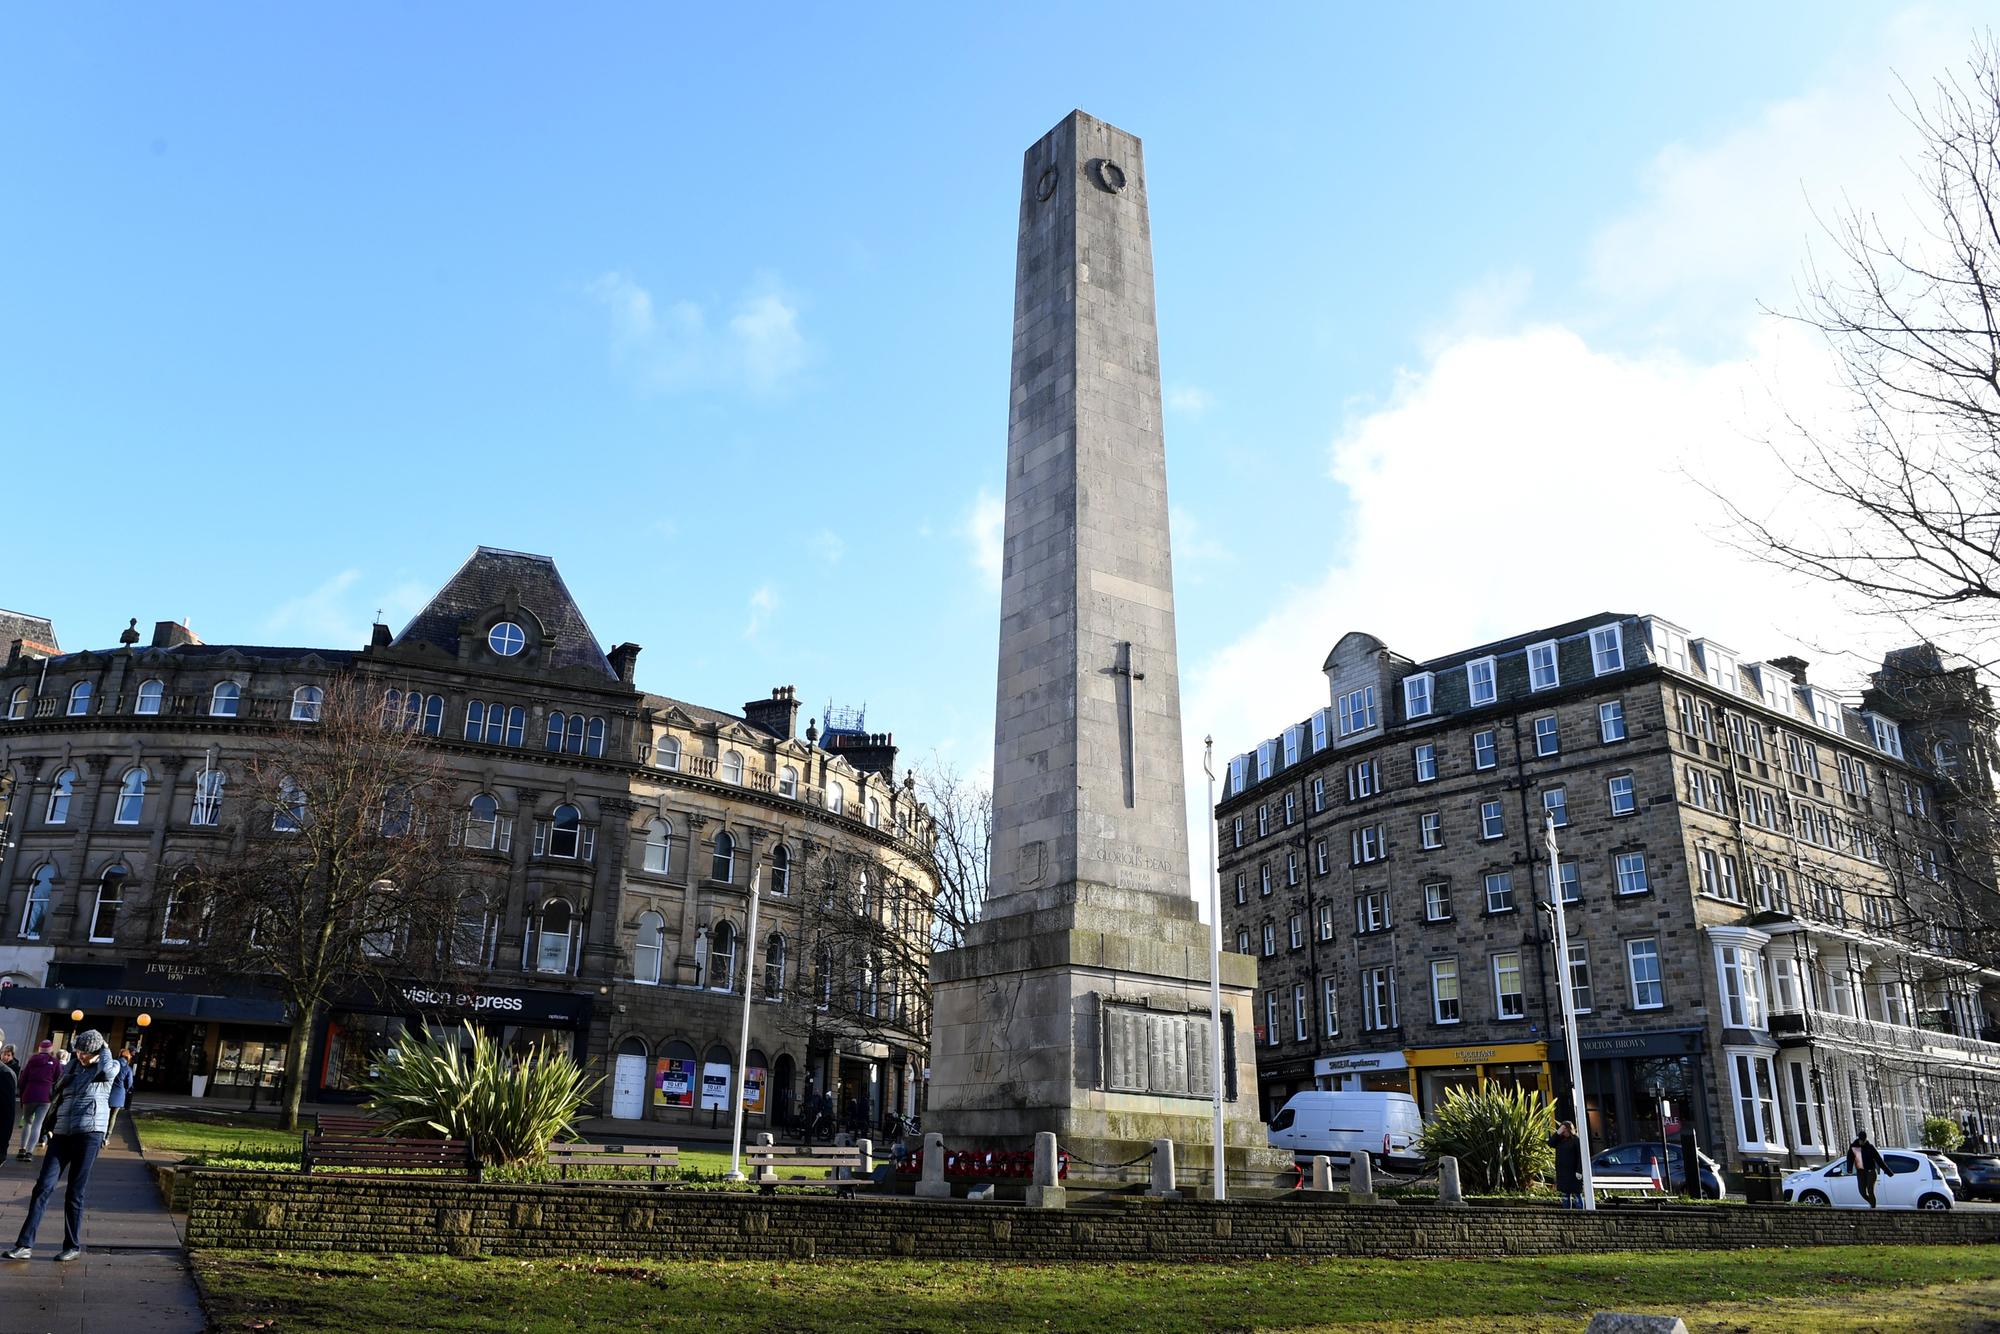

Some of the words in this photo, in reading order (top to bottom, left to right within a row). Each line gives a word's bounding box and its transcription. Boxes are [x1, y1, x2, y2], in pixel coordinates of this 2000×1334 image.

[1096, 849, 1143, 867] GLORIOUS
[1145, 857, 1172, 872] DEAD
[145, 963, 207, 975] JEWELLERS
[167, 973, 184, 981] 1970
[106, 994, 165, 1008] BRADLEYS
[402, 986, 451, 1005] vision
[456, 991, 523, 1011] express
[1583, 1041, 1613, 1050] MOLTON
[1615, 1038, 1646, 1049] BROWN
[1663, 1116, 1680, 1126] ALE
